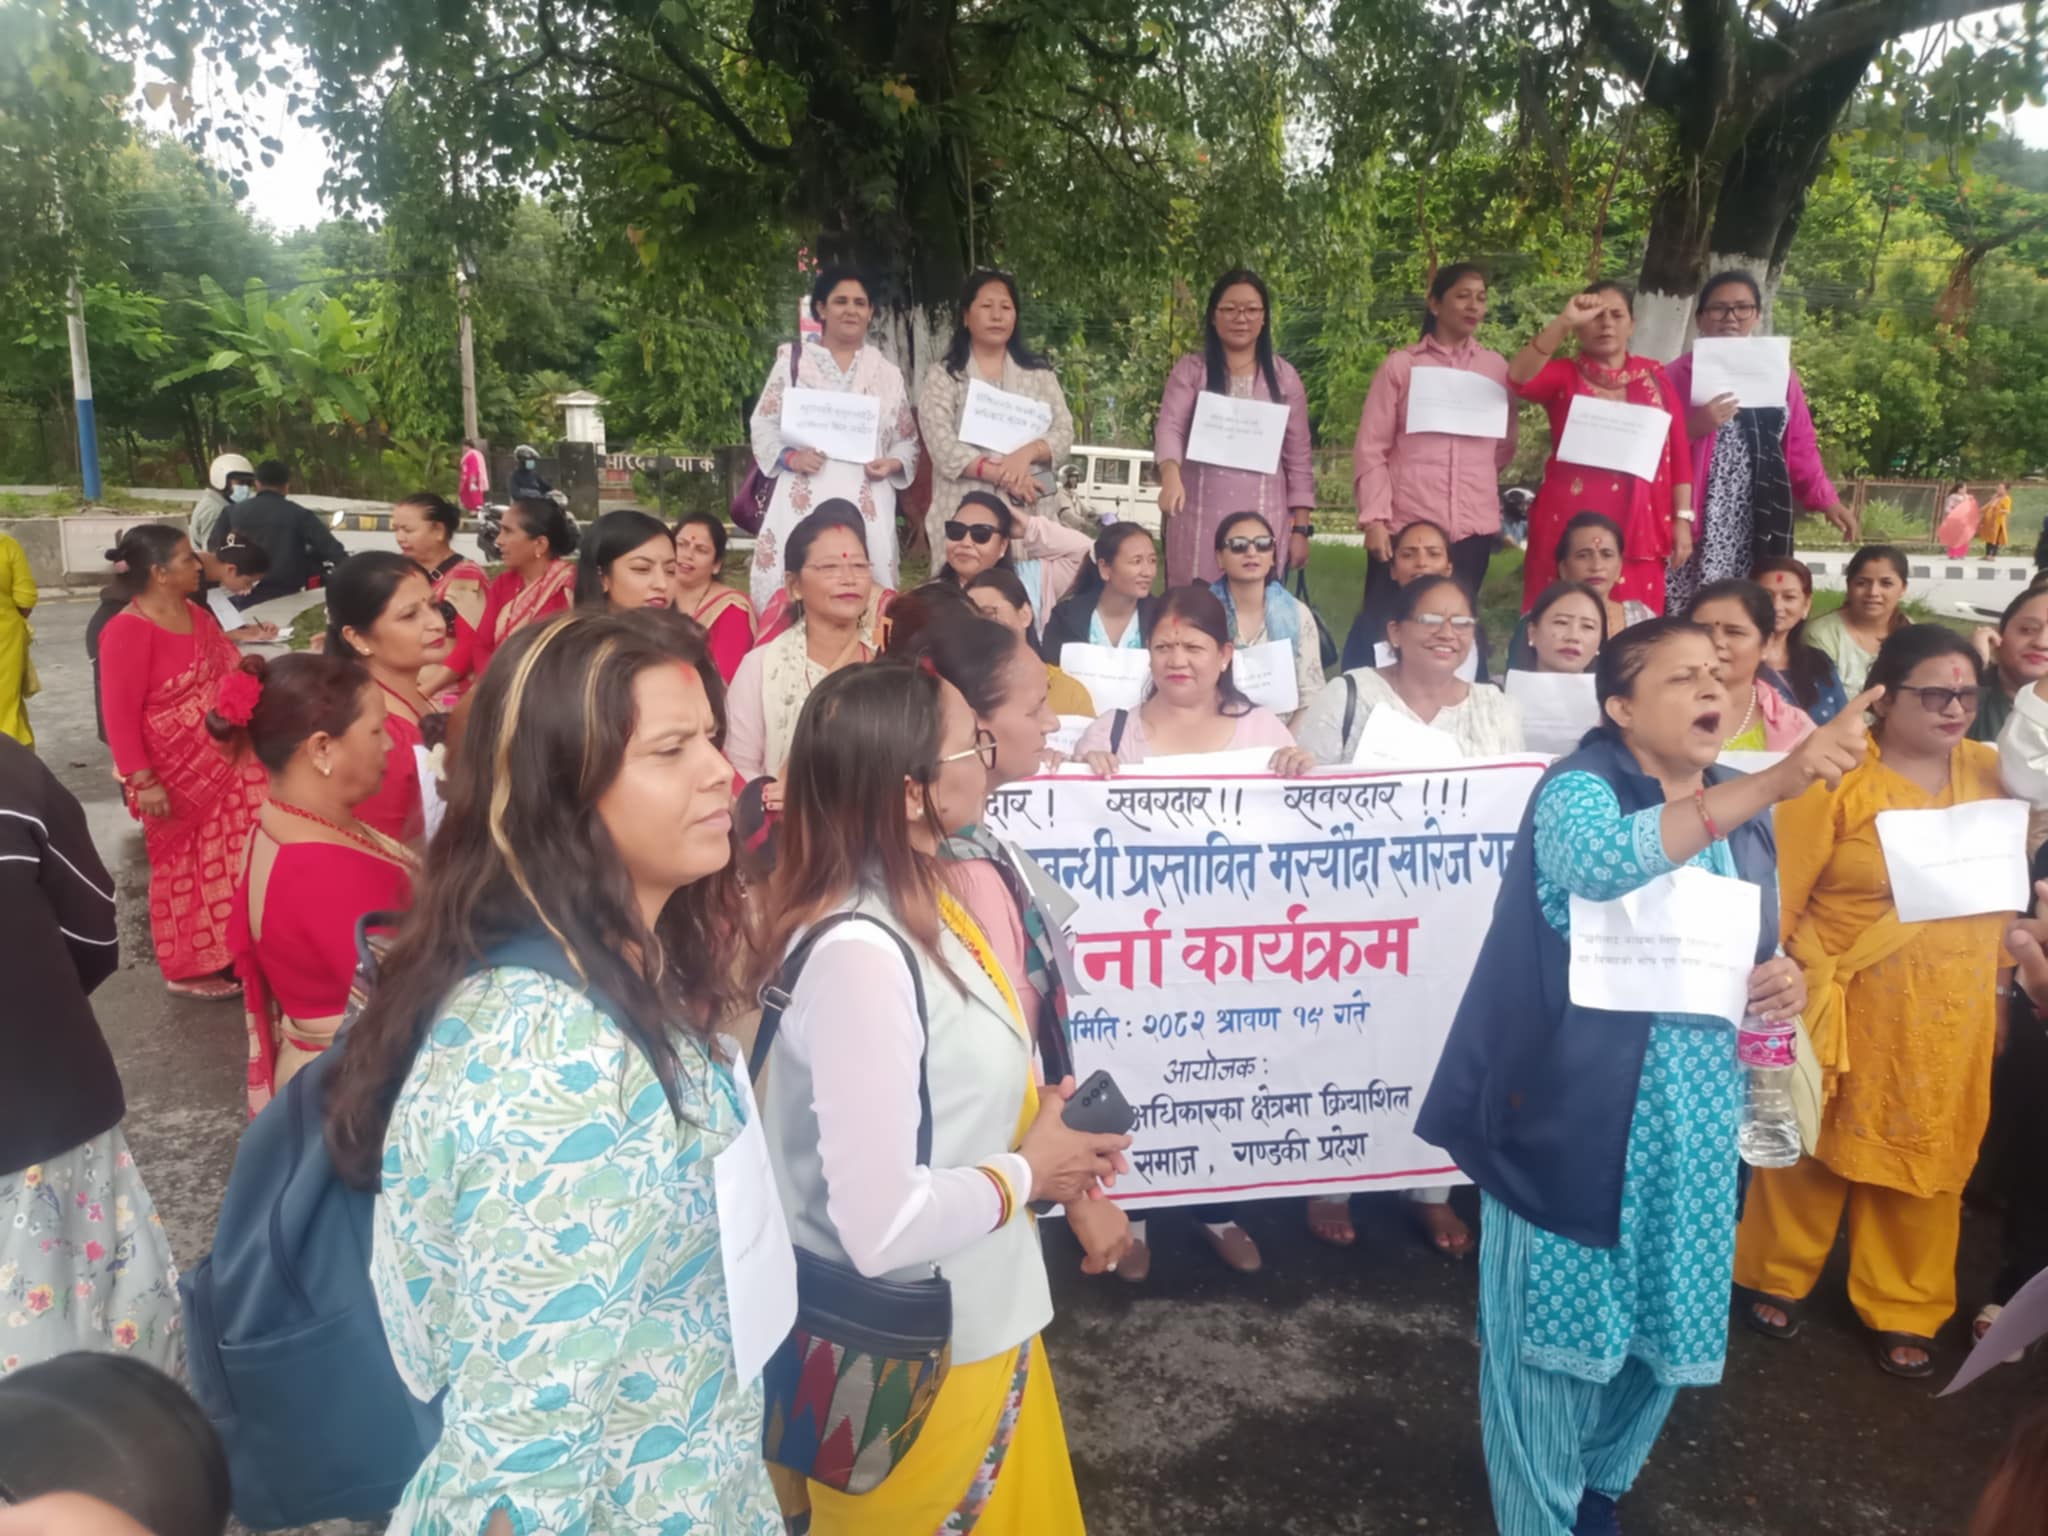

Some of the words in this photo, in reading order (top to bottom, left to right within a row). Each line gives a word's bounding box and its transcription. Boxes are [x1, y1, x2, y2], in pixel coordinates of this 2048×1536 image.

[984, 788, 1041, 831] दार
[1106, 787, 1216, 832] खबरदार
[1284, 782, 1403, 830] खबरदार
[1024, 827, 1120, 901] बन्धी
[1122, 830, 1263, 908] प्रस्तावित
[1074, 907, 1172, 992] र्ना
[1181, 903, 1420, 986] कार्यक्रम
[1142, 1009, 1206, 1043] २०८२
[1217, 1007, 1282, 1035] श्रावण
[1332, 989, 1371, 1035] गते
[1250, 1084, 1312, 1127] क्षेत्रमा
[1319, 1078, 1413, 1117] क्रियाशिल
[1231, 1128, 1311, 1167] गण्डकी
[1318, 1124, 1369, 1167] प्रदेश
